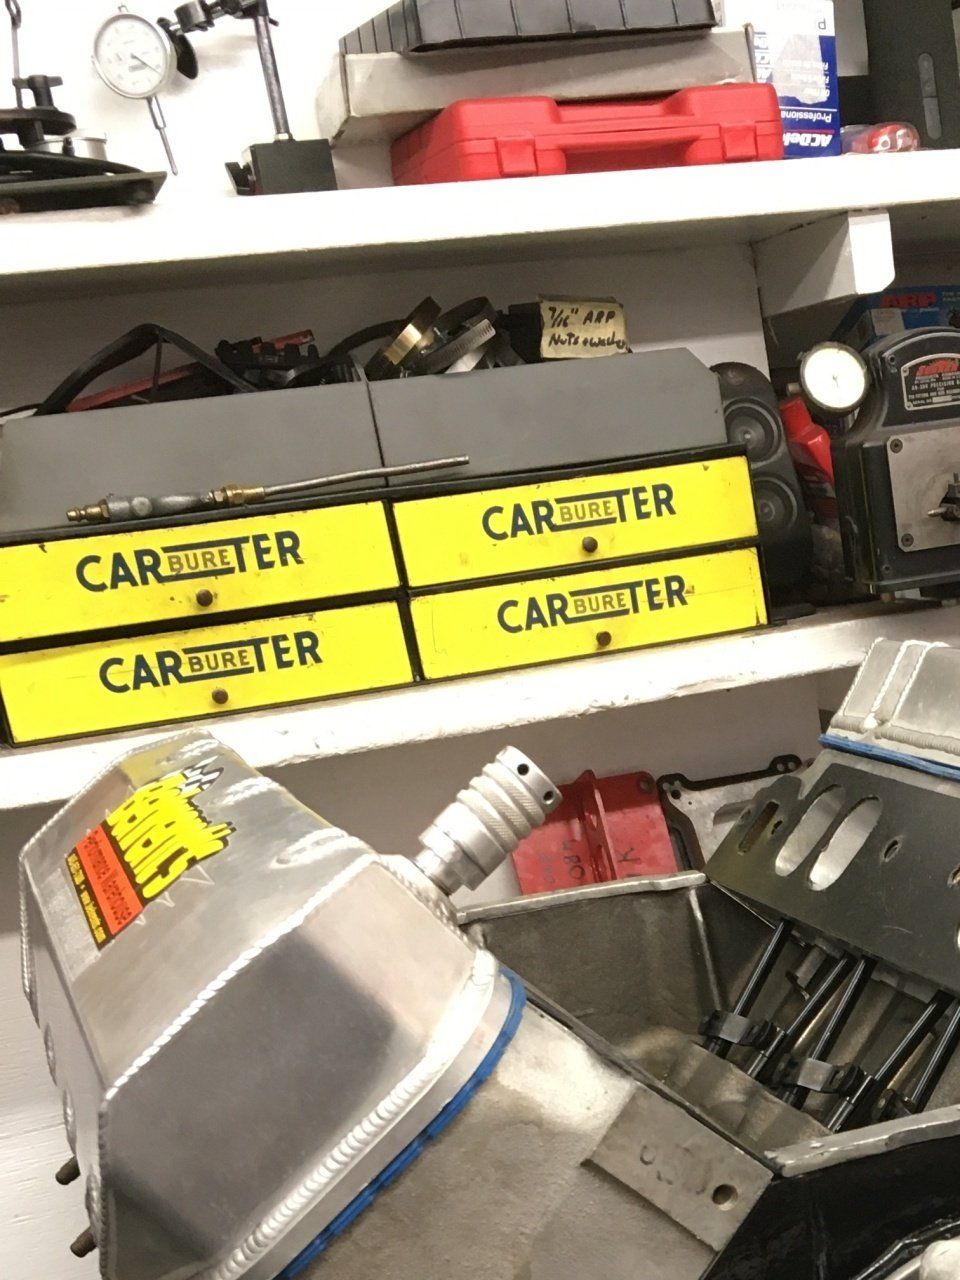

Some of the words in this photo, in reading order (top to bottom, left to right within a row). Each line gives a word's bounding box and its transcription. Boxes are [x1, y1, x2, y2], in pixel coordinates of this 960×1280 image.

[781, 109, 832, 123] Professiona
[782, 133, 833, 147] ACDel
[880, 292, 936, 308] ARP
[583, 310, 616, 325] ARP
